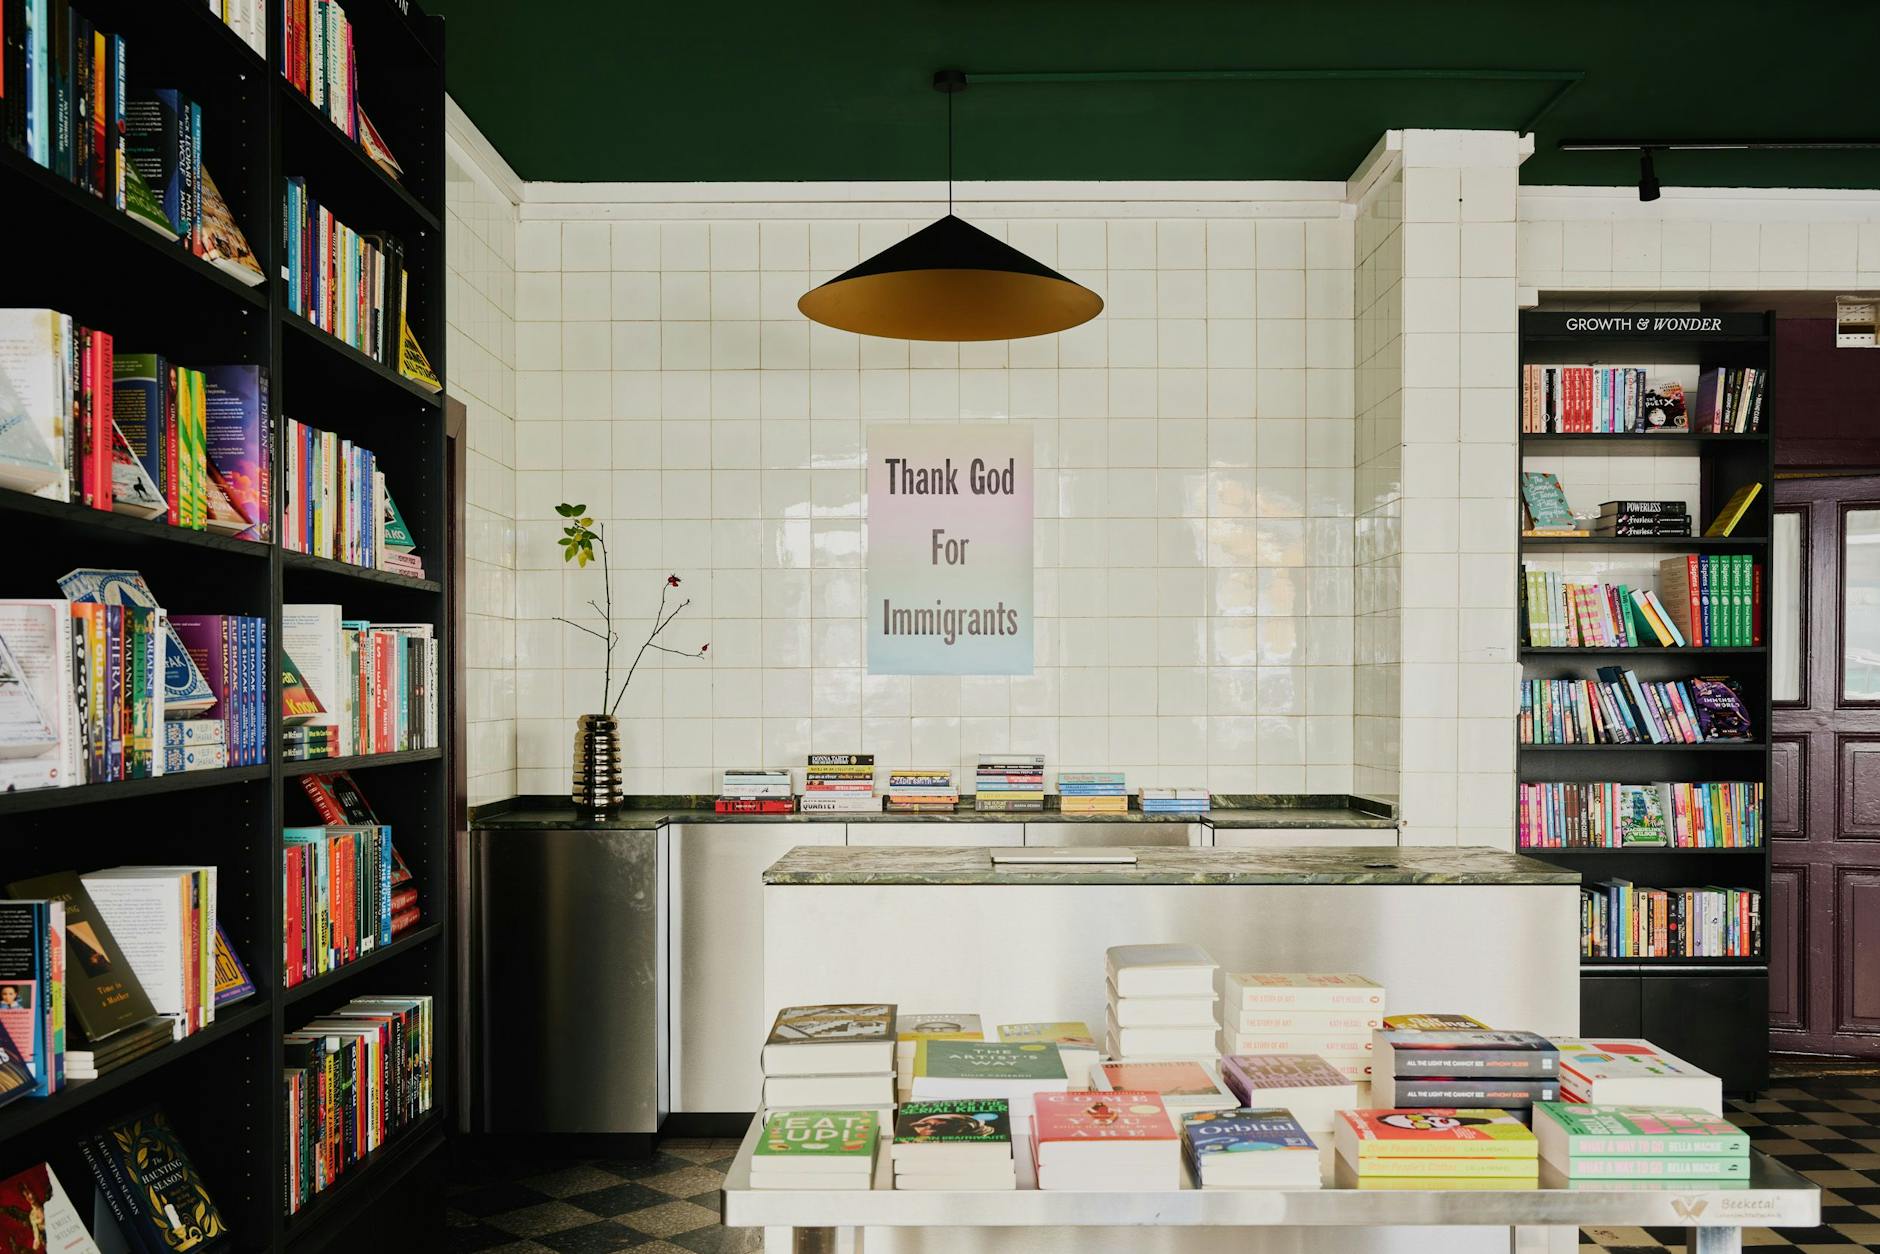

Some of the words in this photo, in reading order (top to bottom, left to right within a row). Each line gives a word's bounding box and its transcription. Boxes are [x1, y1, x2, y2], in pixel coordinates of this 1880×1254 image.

[1566, 318, 1632, 331] GROWTH
[1637, 318, 1650, 331] &
[1654, 318, 1722, 331] WONDER
[1664, 399, 1674, 407] X
[885, 458, 958, 494] Thank
[970, 458, 1014, 494] God
[1626, 502, 1661, 512] POWERLESS
[1628, 515, 1653, 524] Fearless
[1628, 527, 1654, 536] Fearless
[932, 529, 970, 566] For
[1691, 564, 1699, 587] Sapiens
[96, 609, 104, 640] THE
[884, 599, 1018, 646] Immigrants
[96, 644, 104, 677] OLD
[112, 637, 120, 690] HERA
[96, 682, 104, 729] DRIFT
[286, 700, 318, 715] Know
[302, 776, 323, 802] DEATH
[722, 800, 766, 810] TRUST
[901, 1106, 951, 1114] SERIAL
[956, 1106, 1008, 1114] KILLER
[785, 1117, 861, 1129] EAT
[1200, 1124, 1295, 1134] Orbital
[787, 1128, 850, 1142] UP!
[1579, 1141, 1605, 1153] WHAT
[1608, 1141, 1614, 1153] A
[1616, 1141, 1635, 1153] WAY
[1639, 1141, 1649, 1153] TO
[1652, 1141, 1664, 1153] GO
[1668, 1141, 1692, 1153] BELLA
[1694, 1141, 1722, 1153] MACKIE
[142, 1159, 182, 1184] HAUNTING
[1578, 1162, 1604, 1173] WHAT
[1607, 1162, 1613, 1173] A
[1615, 1162, 1635, 1173] WAY
[1638, 1162, 1649, 1173] TO
[1651, 1162, 1664, 1173] GO
[1668, 1162, 1690, 1173] BELLA
[1692, 1162, 1721, 1173] MACKIE
[83, 1148, 108, 1192] HAUNTING
[105, 1190, 125, 1222] SEASON
[98, 1141, 124, 1184] HAUNTING
[120, 1183, 140, 1216] SEASON
[153, 1173, 184, 1192] SEASON
[1721, 1199, 1775, 1210] Beeketal
[54, 1224, 80, 1241] WILSON
